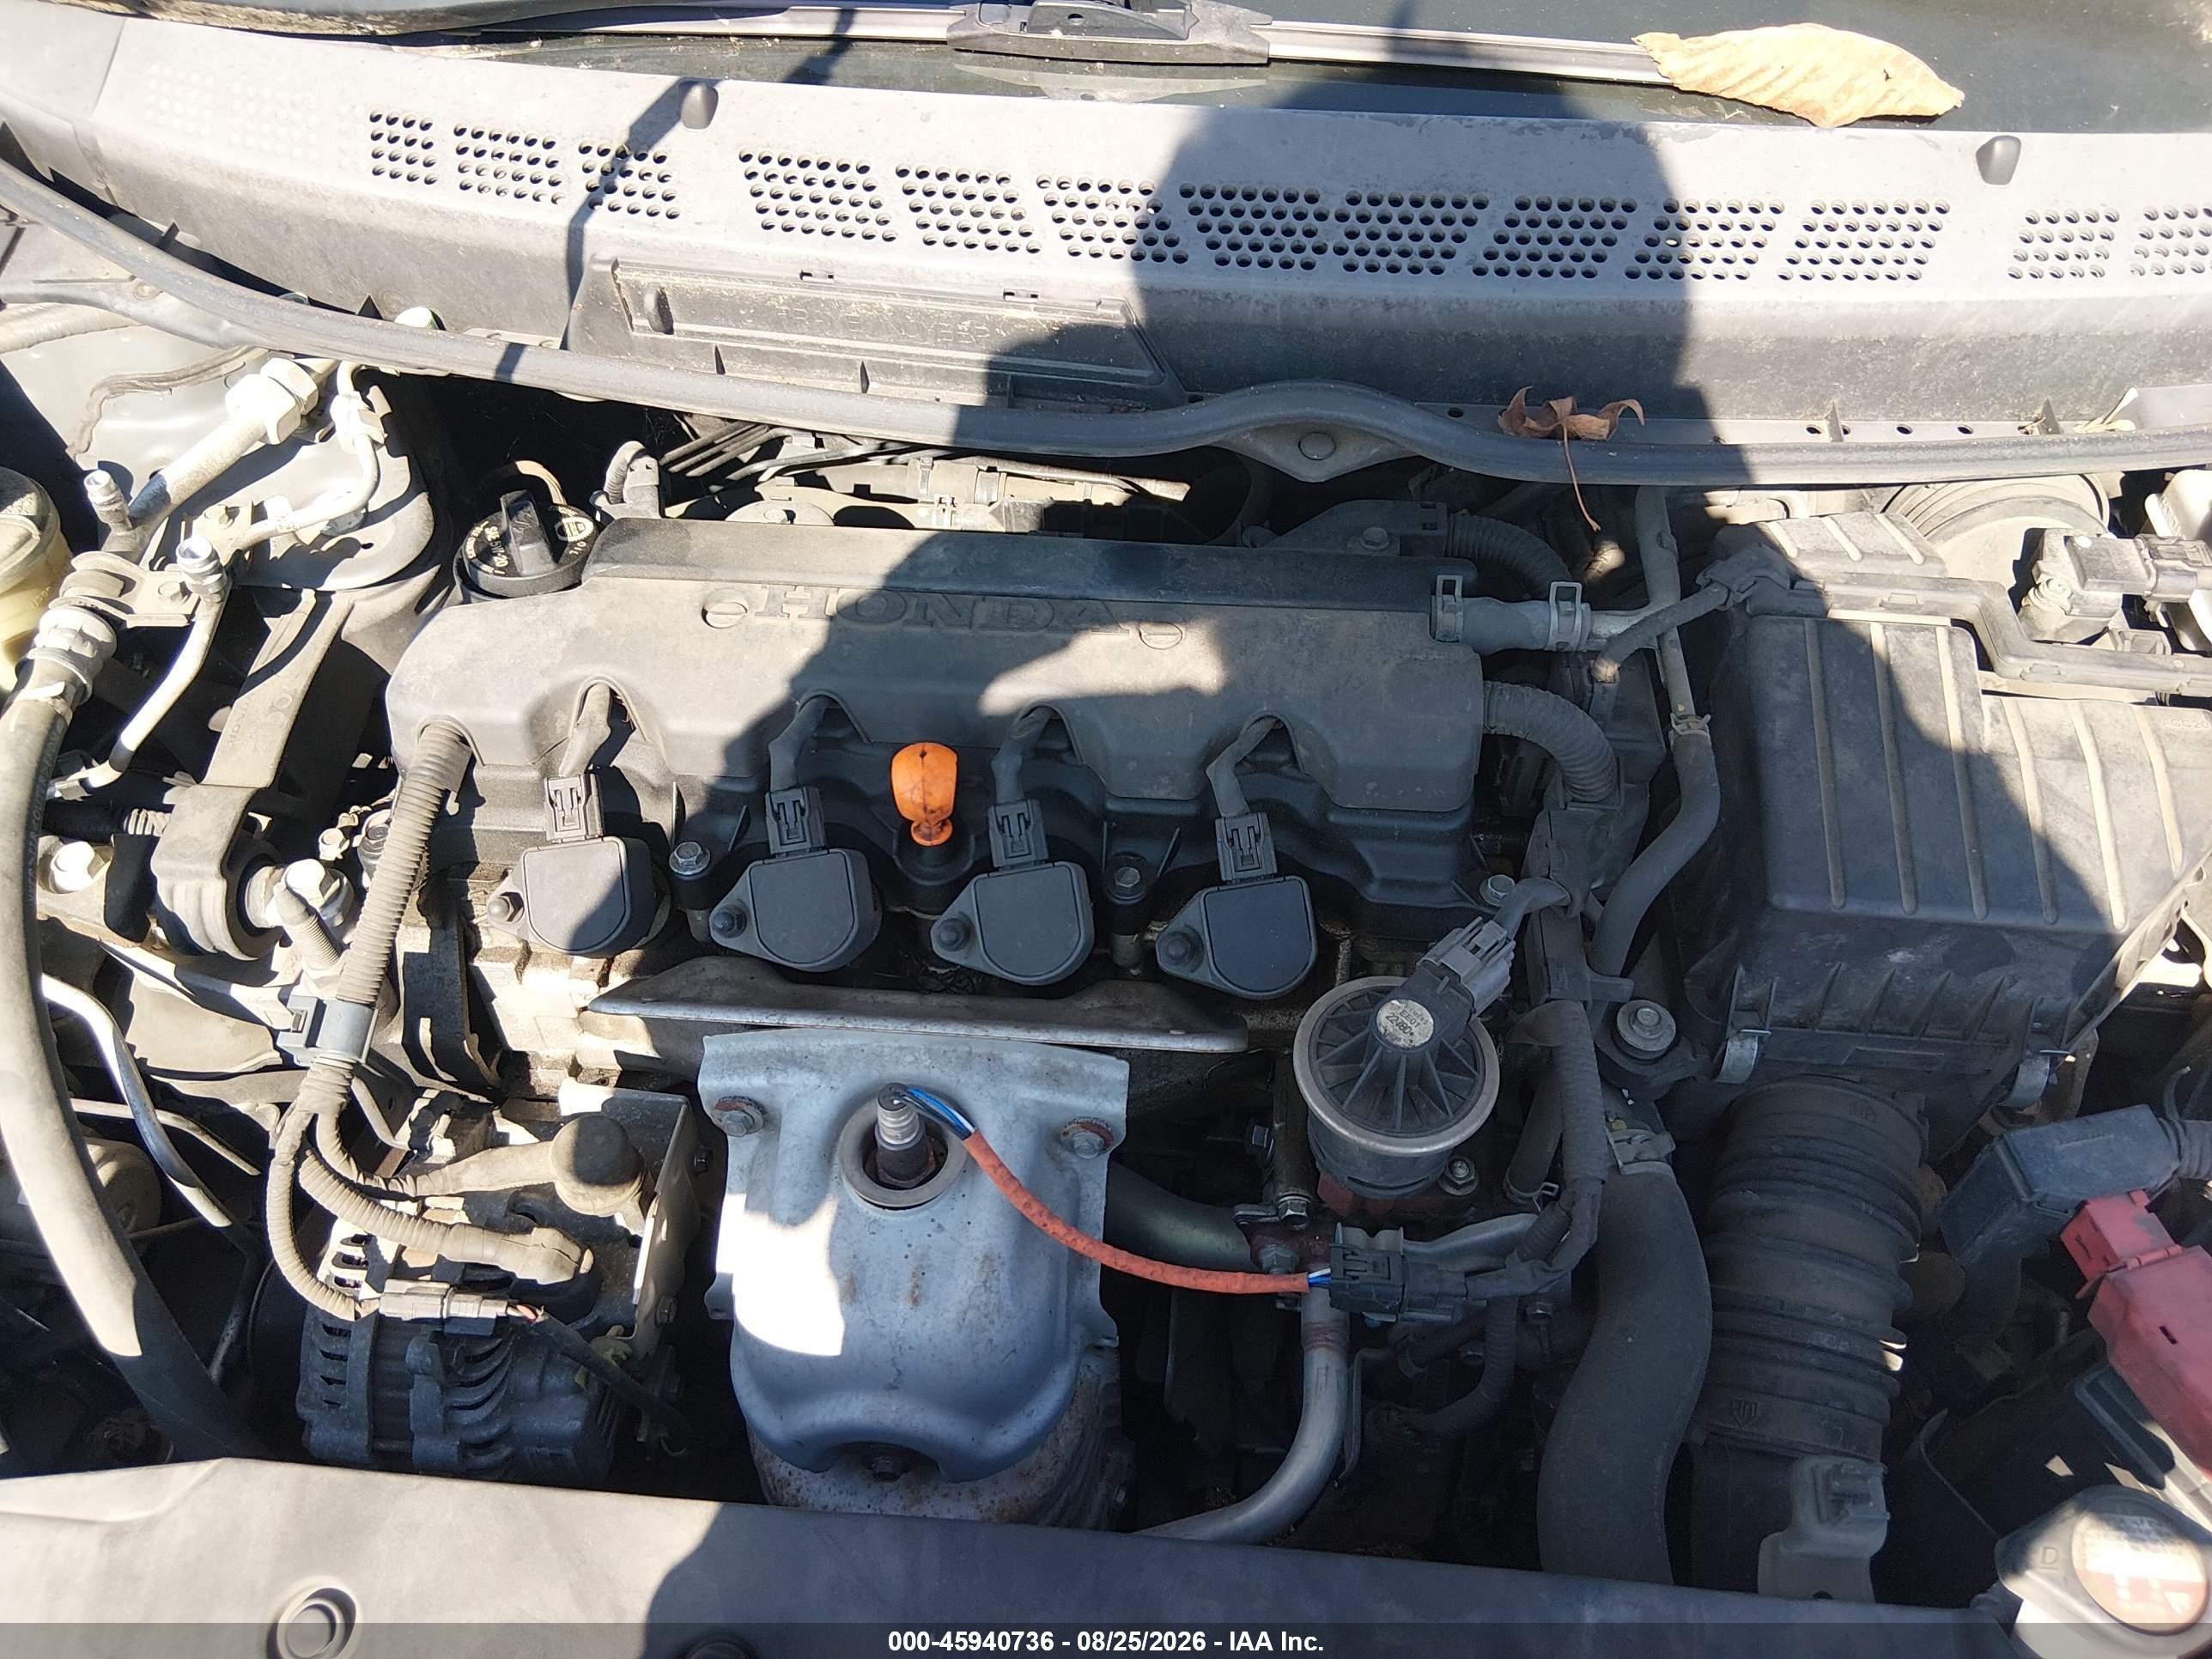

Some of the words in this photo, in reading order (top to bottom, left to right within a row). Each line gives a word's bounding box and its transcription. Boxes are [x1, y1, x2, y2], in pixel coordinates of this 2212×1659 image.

[568, 541, 586, 556] OIL
[755, 585, 1133, 636] HONDA
[1400, 1009, 1421, 1029] EE01
